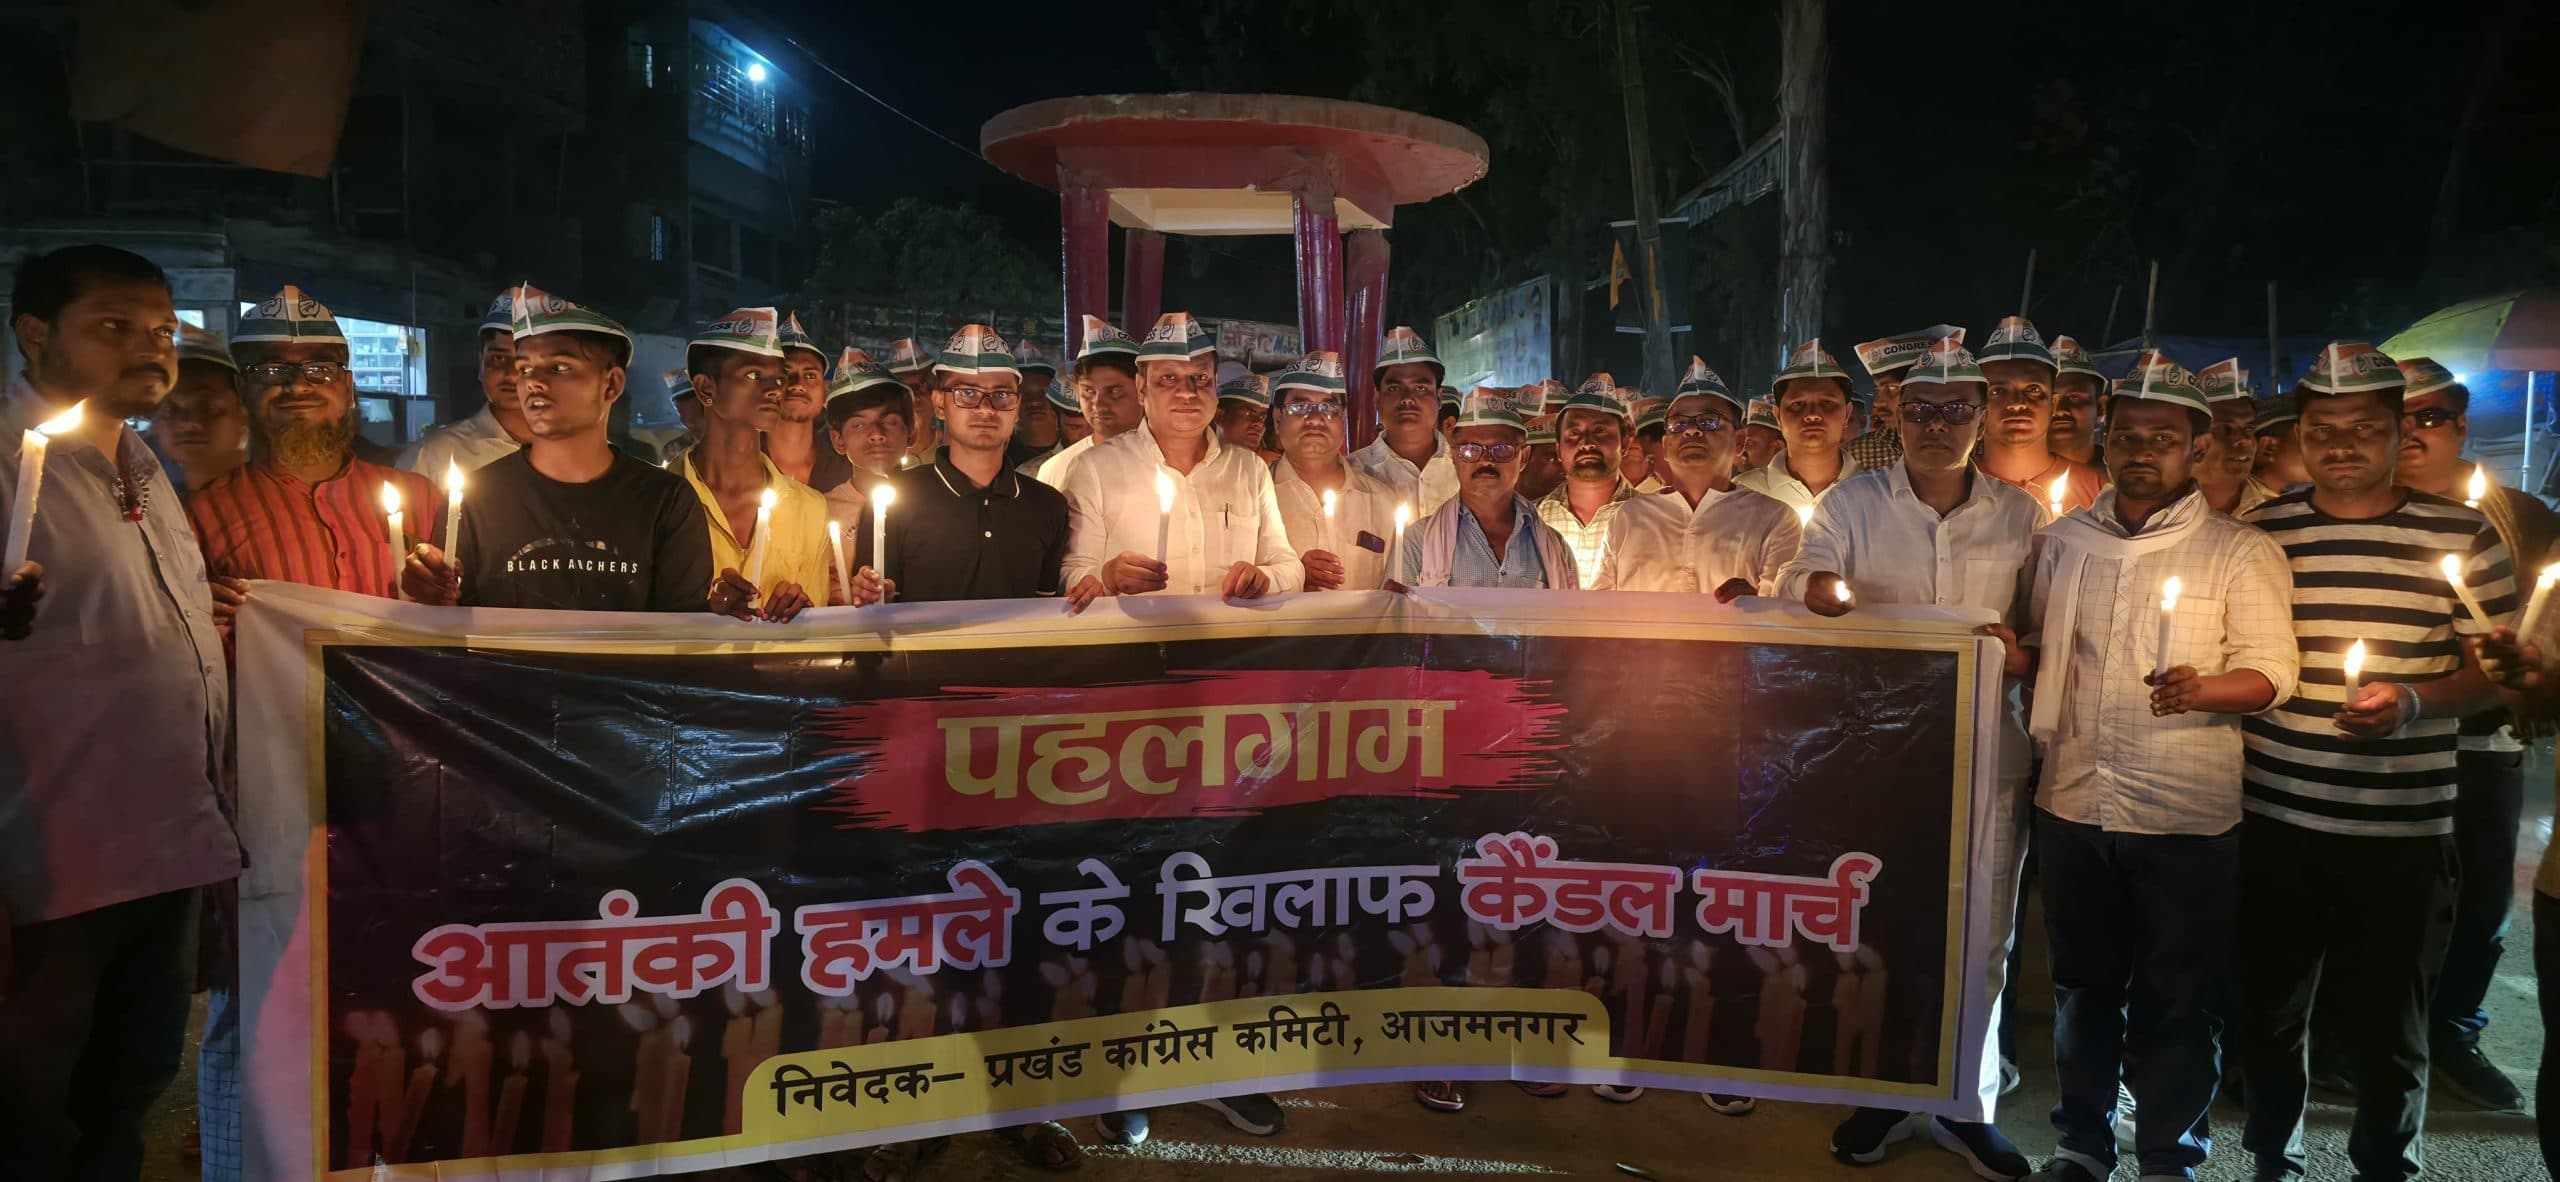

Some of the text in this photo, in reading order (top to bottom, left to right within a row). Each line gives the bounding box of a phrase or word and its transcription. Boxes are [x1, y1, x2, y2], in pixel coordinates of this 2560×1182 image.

[507, 558, 560, 573] BLACK
[937, 699, 1457, 806] पहलगाम
[412, 831, 1882, 1011] आतंकी हमले के खिलाफ कैंडल मार्च
[984, 1036, 1092, 1089] प्रखंड
[1102, 1019, 1219, 1072] कांग्रेस
[1232, 1001, 1364, 1056] कमिटी,
[1380, 1010, 1588, 1046] आजमनगर
